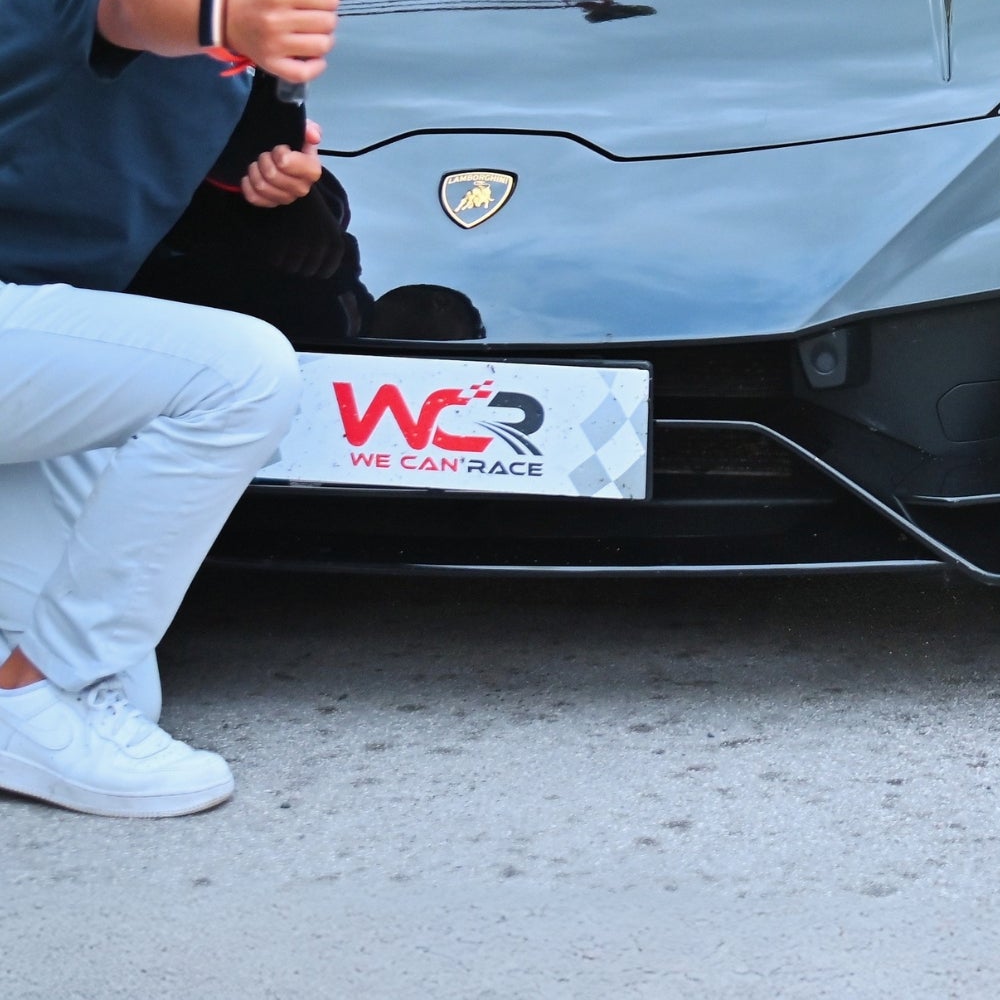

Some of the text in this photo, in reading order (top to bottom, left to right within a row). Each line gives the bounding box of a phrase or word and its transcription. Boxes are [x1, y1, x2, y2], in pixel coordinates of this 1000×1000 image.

[447, 174, 509, 185] LAMBORGHINI
[350, 452, 392, 469] WE
[467, 460, 544, 477] RACE
